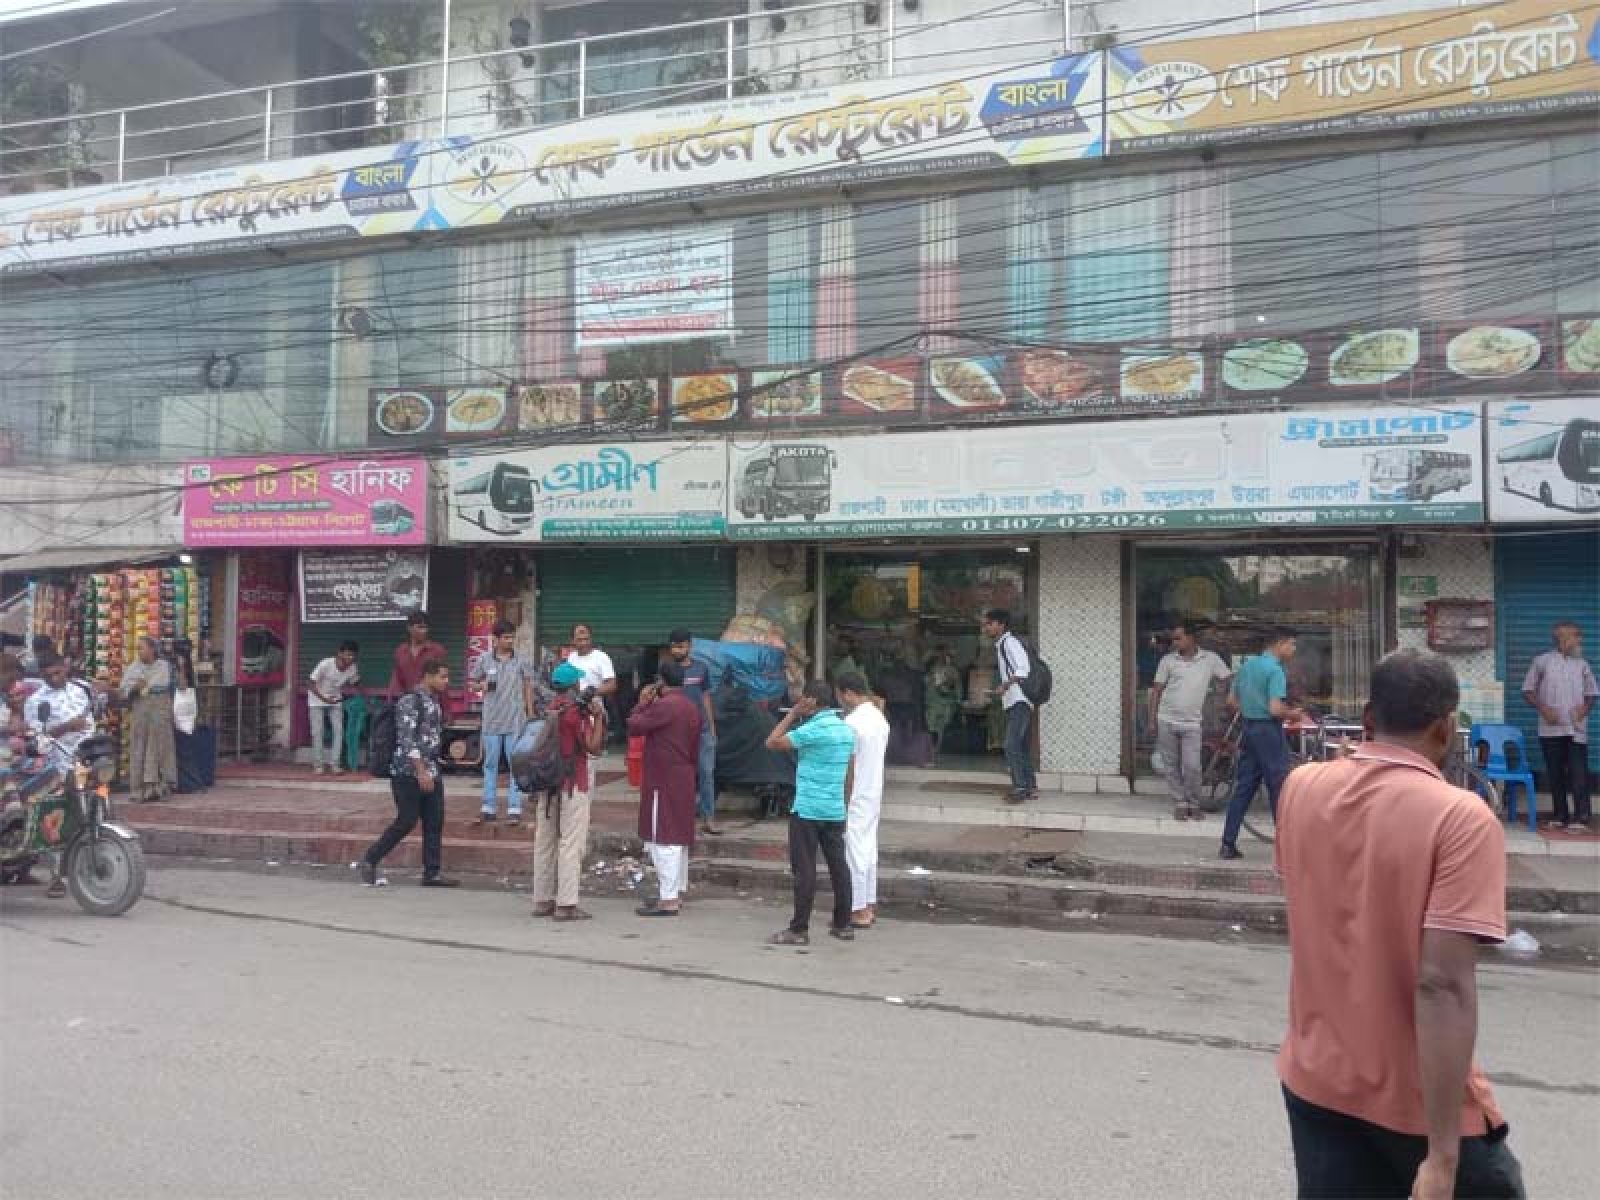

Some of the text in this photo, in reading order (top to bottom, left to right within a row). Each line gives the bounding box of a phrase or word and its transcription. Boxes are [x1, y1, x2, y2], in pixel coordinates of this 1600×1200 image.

[1221, 57, 1292, 106] শেফ
[1302, 37, 1402, 98] গার্ডেন
[997, 79, 1069, 108] বাংলা
[354, 162, 406, 188] বাংলা
[328, 461, 416, 497] হানিফ
